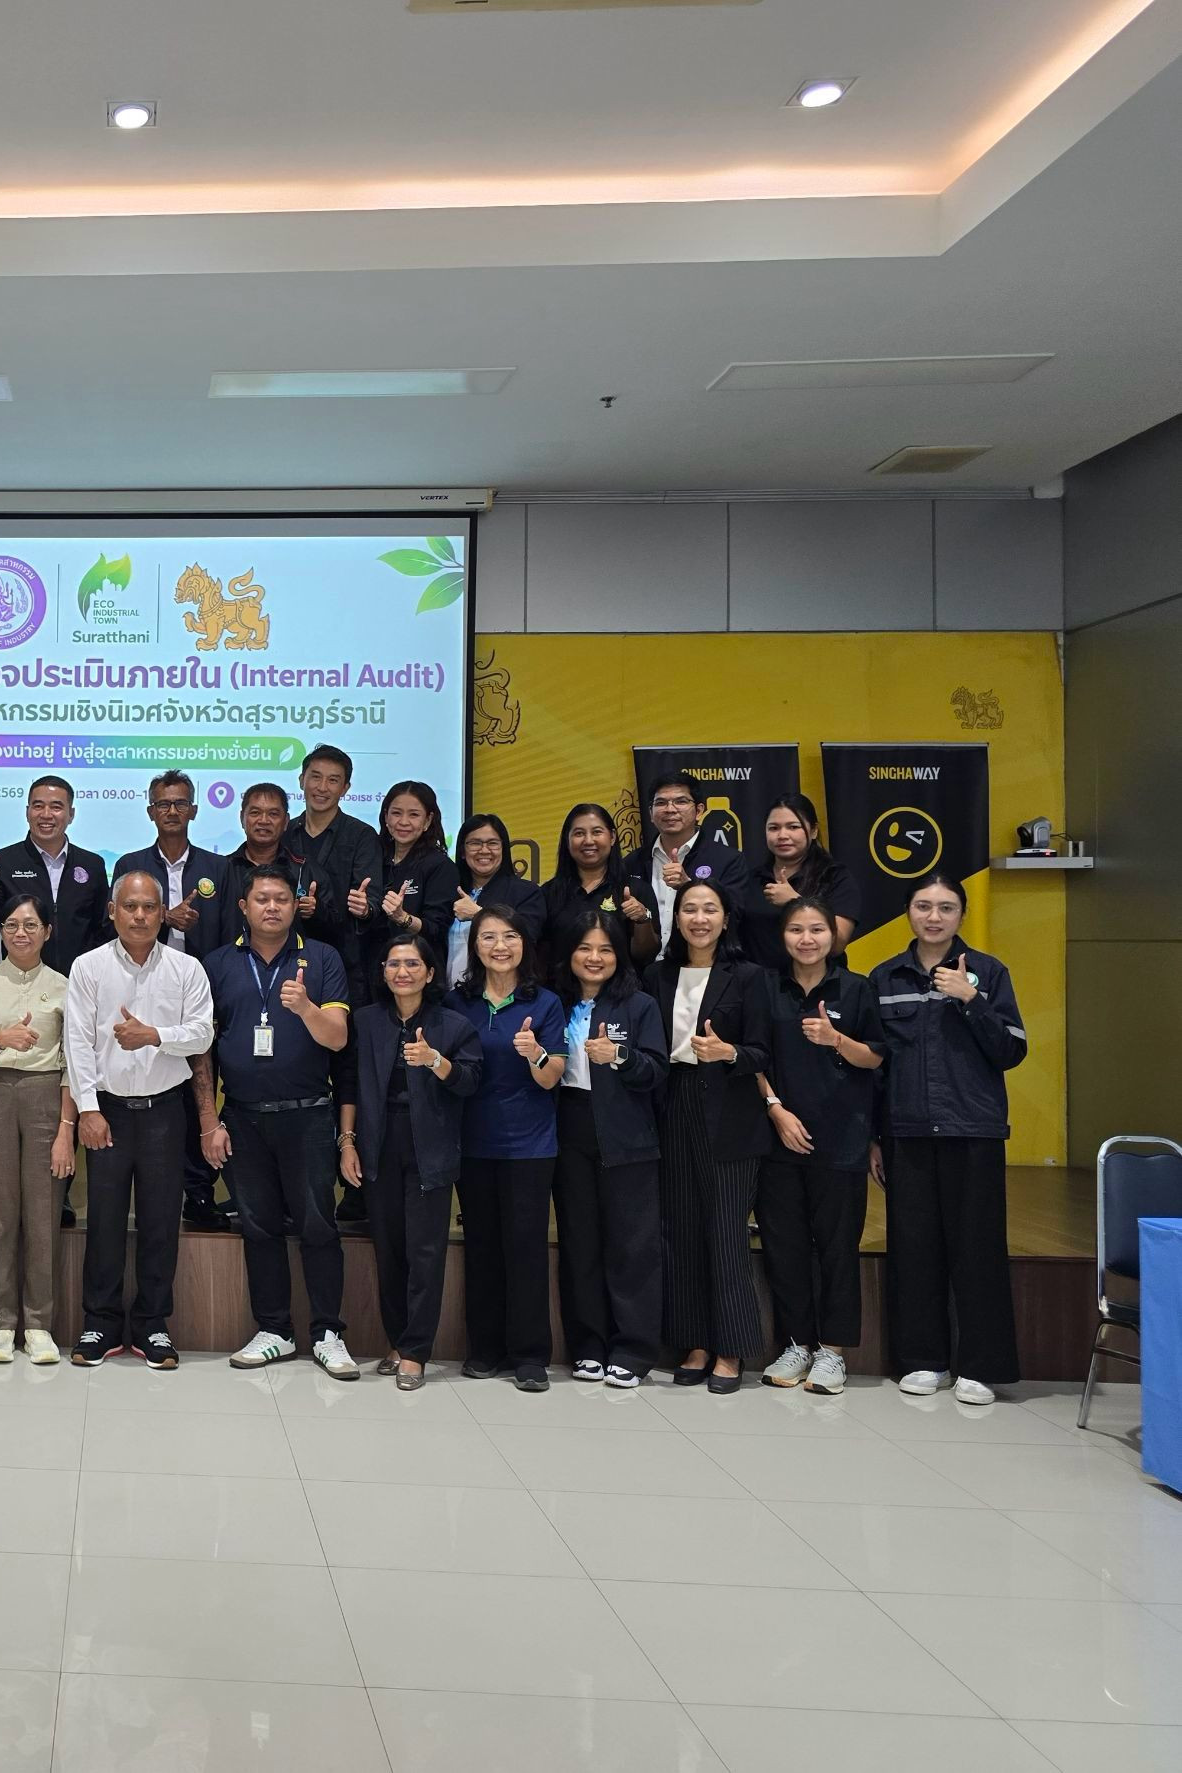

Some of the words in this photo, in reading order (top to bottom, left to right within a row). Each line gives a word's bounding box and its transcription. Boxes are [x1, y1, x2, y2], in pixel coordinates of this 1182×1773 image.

[93, 600, 115, 608] ECO
[93, 609, 140, 617] INDUSTRIAL
[93, 617, 118, 625] TOWN
[4, 622, 36, 646] INDUSTRY
[72, 630, 150, 644] Suratthani
[230, 661, 349, 690] (Internal
[355, 663, 445, 692] Audit)
[61, 740, 272, 764] มุ่งสู่อุตสาหกรรมอย่างยั่งยืน
[869, 766, 941, 781] SINGHAWAY
[102, 789, 148, 800] 09.00–1
